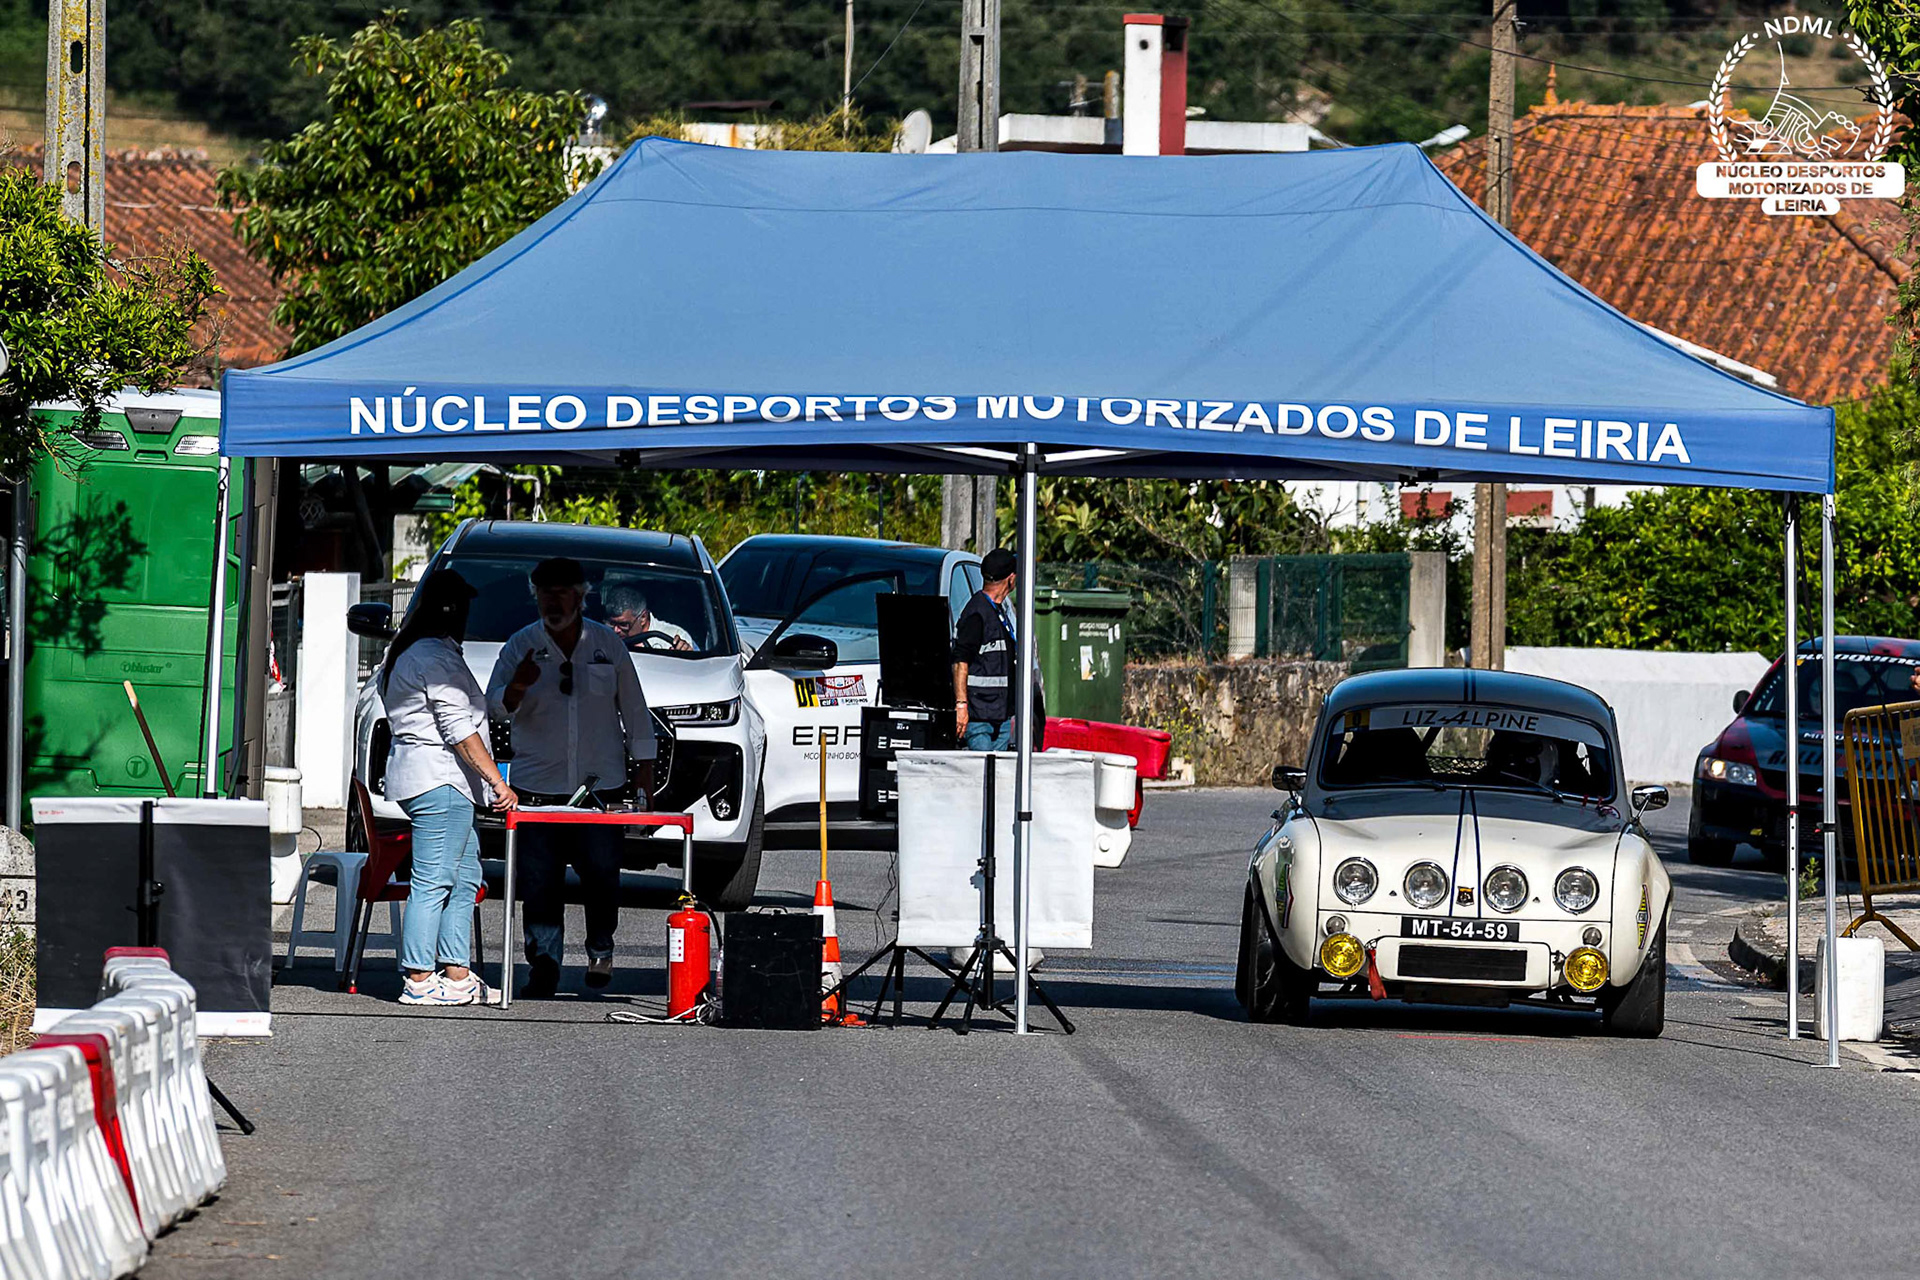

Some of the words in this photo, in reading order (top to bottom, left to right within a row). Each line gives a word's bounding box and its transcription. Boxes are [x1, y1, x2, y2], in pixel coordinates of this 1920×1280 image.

[350, 387, 587, 434] NÚCLEO
[606, 396, 956, 428] DESPORTOS
[977, 396, 1396, 441] MOTORIZADOS
[1414, 410, 1489, 450] DE
[1509, 416, 1691, 463] LEIRIA
[804, 752, 844, 760] MCOTINHO
[1412, 919, 1508, 940] MT-54-59
